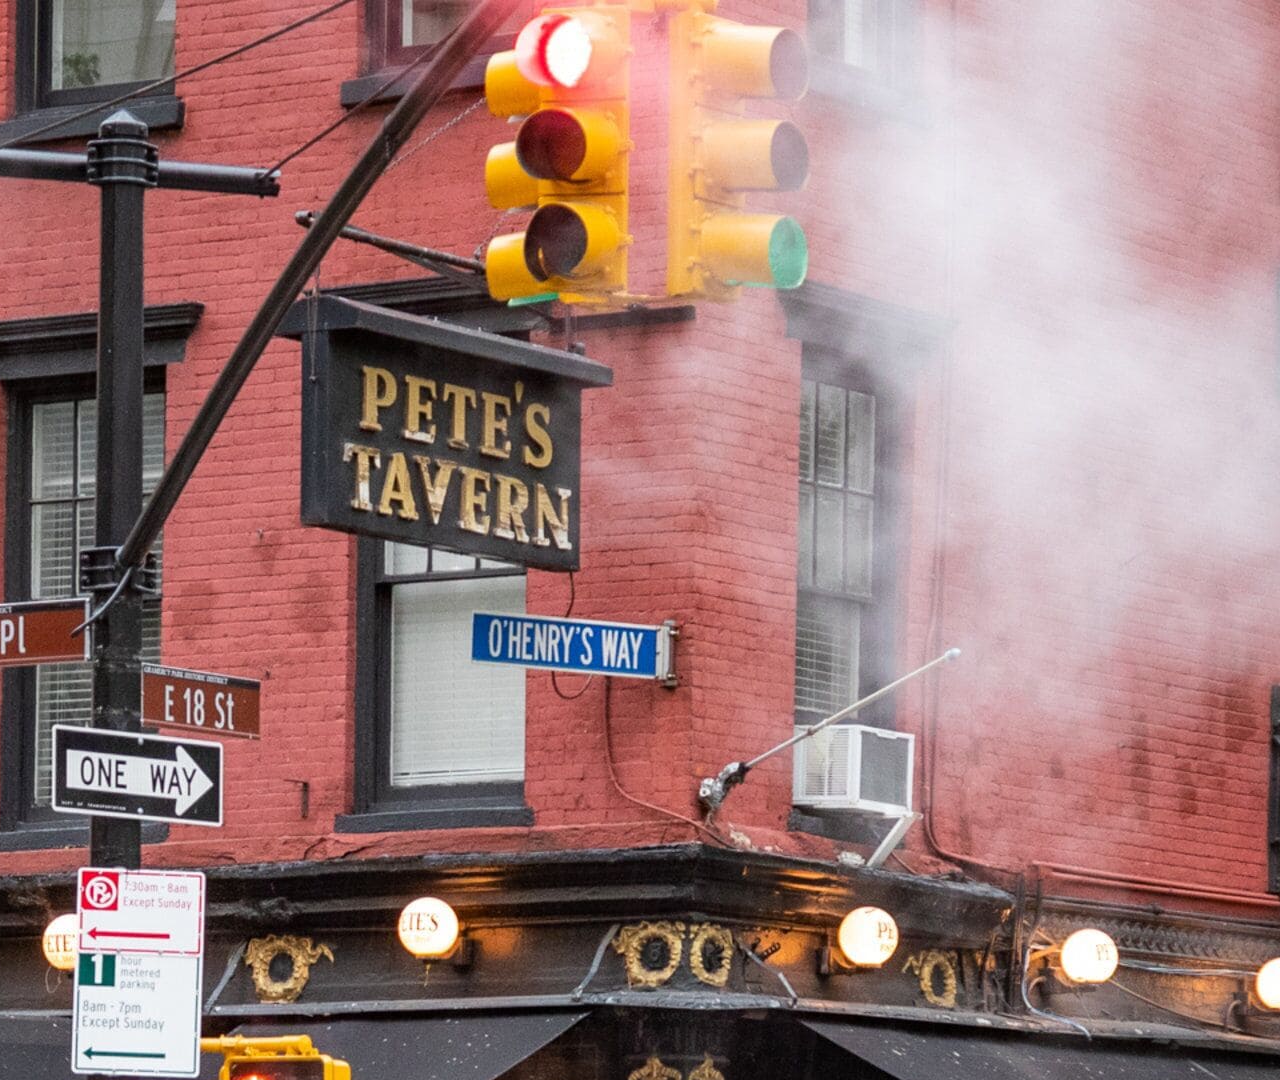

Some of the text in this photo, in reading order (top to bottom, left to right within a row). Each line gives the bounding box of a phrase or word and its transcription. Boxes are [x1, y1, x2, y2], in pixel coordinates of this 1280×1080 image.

[358, 364, 554, 470] PETE'S
[342, 441, 573, 552] TAVERN
[0, 615, 26, 655] Pl
[488, 619, 644, 670] O'HENRY'S WAY
[165, 685, 234, 730] E 18 St
[80, 756, 196, 796] ONE WAY
[123, 880, 158, 893] 7:30am
[167, 881, 188, 894] 8am
[122, 898, 192, 910] Except Sunday
[91, 953, 104, 984] 1
[120, 956, 142, 966] hour
[119, 979, 156, 990] parking
[120, 968, 161, 978] metered
[82, 1000, 106, 1012] 8am
[119, 1000, 141, 1014] 7pm
[81, 1016, 165, 1032] Except Sunday
